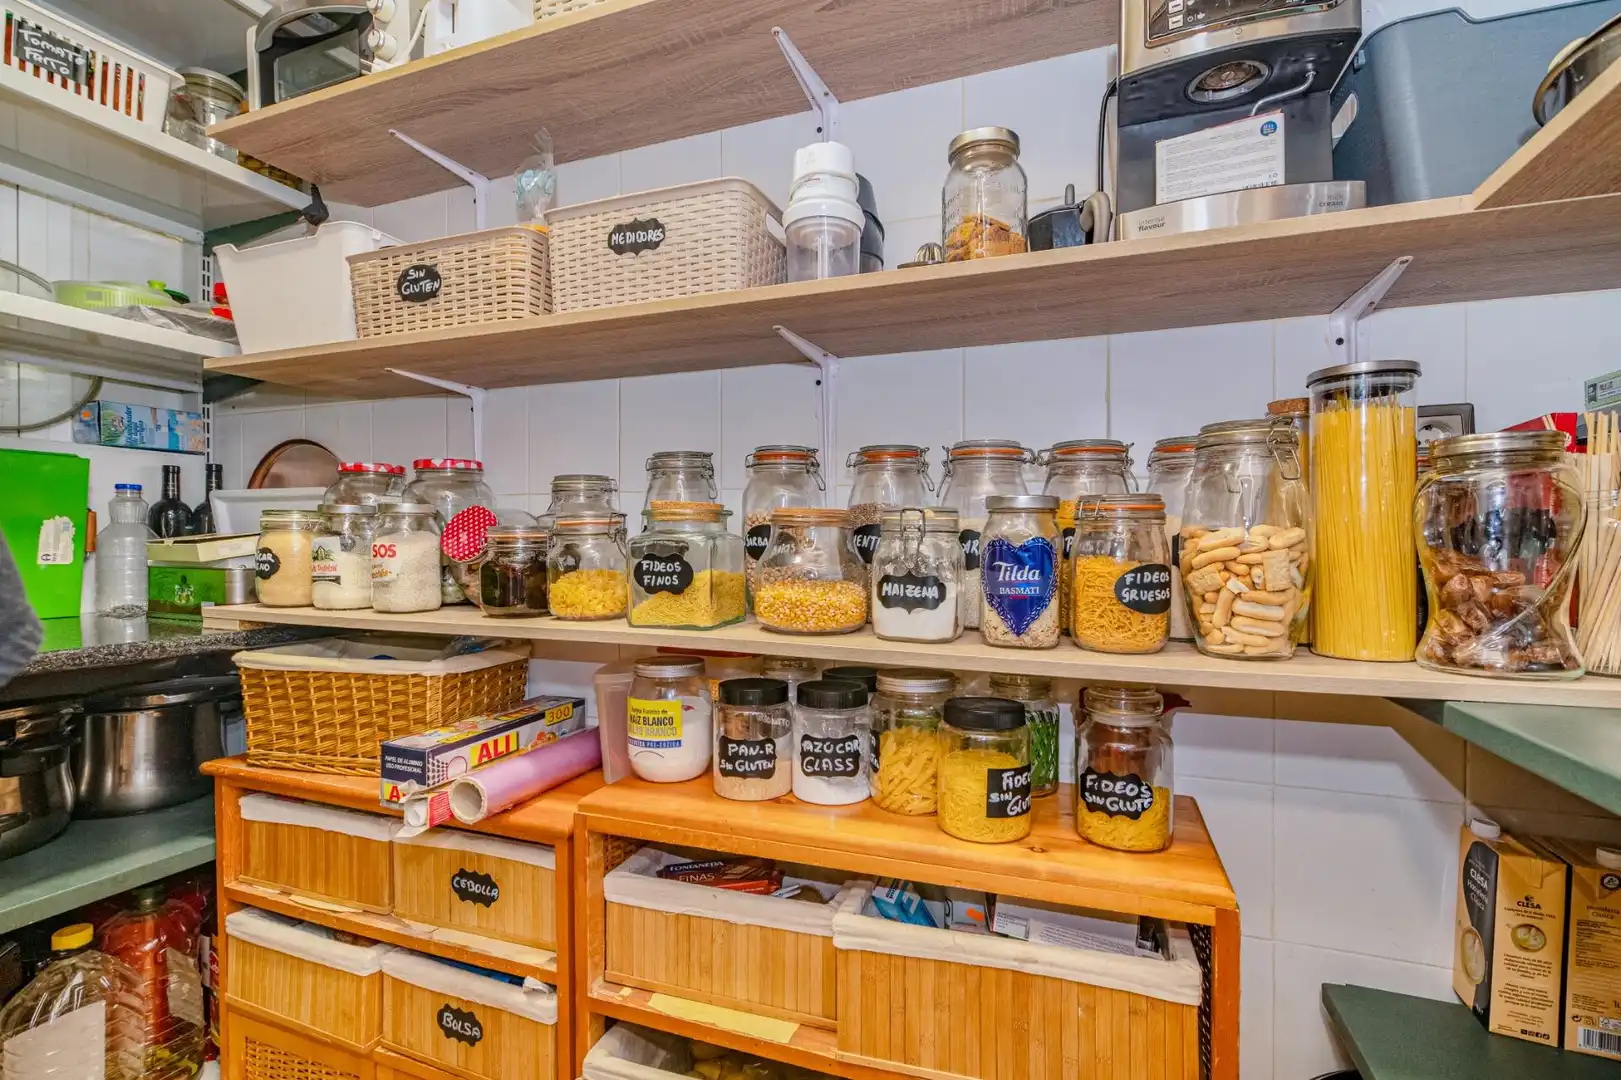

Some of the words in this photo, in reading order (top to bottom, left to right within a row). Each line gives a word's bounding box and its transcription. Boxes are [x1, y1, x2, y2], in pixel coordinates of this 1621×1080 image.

[24, 46, 70, 75] FRITO
[1138, 222, 1166, 231] flavour
[407, 269, 426, 280] SIN
[401, 279, 441, 295] GLUTEN
[371, 543, 397, 559] SOS
[641, 560, 682, 572] FIDEOS
[992, 561, 1041, 581] Tilda
[643, 574, 679, 587] FINOS
[1124, 571, 1169, 585] FIDEOS
[881, 582, 939, 599] MAIZENA
[1000, 586, 1040, 595] BASMATI
[1121, 587, 1171, 603] GRUESOS
[547, 706, 570, 722] 300
[643, 716, 674, 727] BLANCO
[477, 734, 512, 764] ALI
[734, 759, 775, 772] GLUTEN
[803, 756, 854, 772] GLASS
[1086, 774, 1152, 798] FIDEOS
[988, 791, 1013, 803] SIN
[1084, 791, 1105, 805] SIN
[669, 861, 725, 872] FONTANEDA
[453, 876, 499, 900] CEBOLLA
[1516, 900, 1542, 910] CLESA
[442, 1012, 481, 1039] BOLSA
